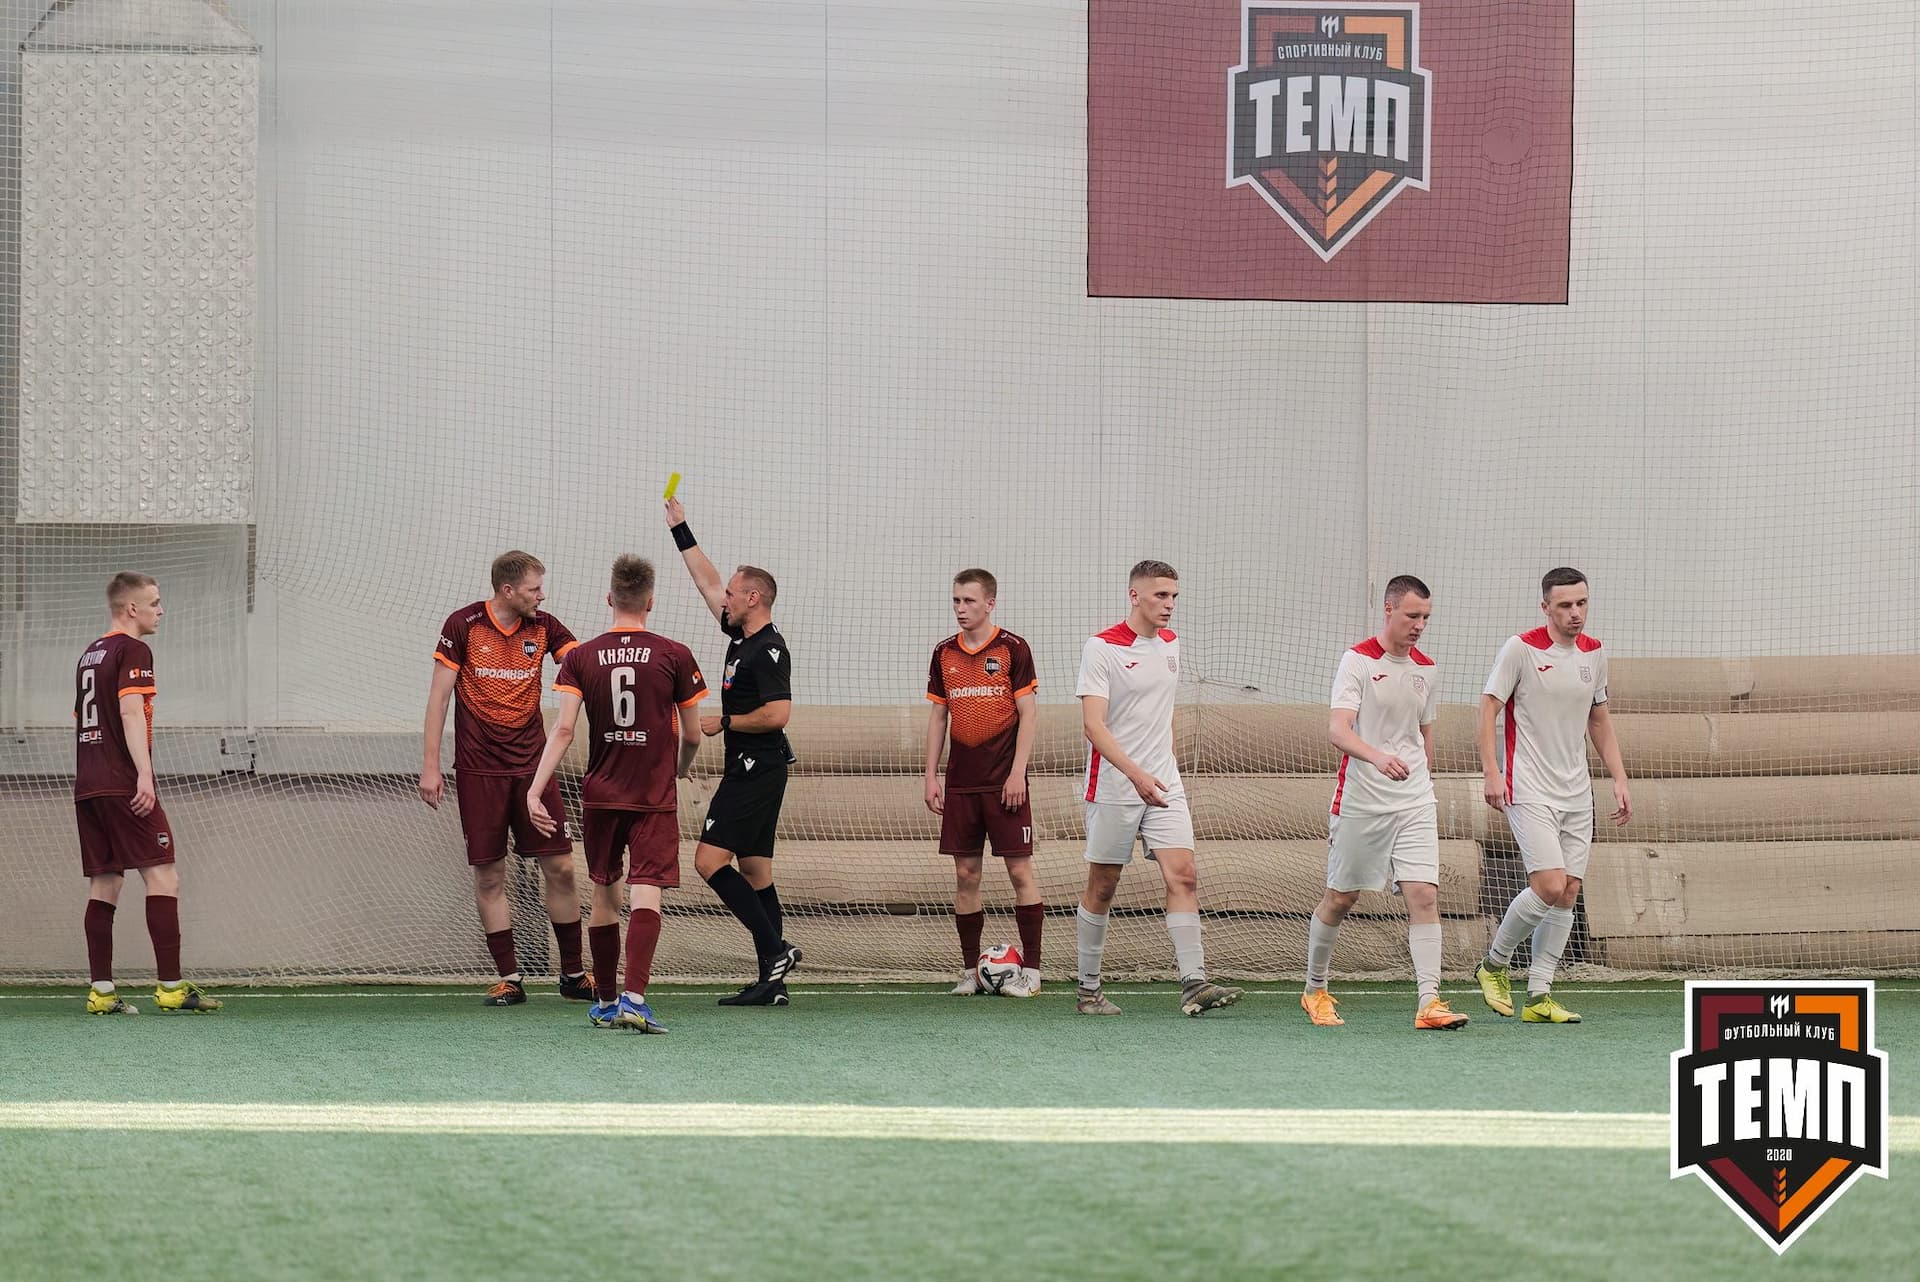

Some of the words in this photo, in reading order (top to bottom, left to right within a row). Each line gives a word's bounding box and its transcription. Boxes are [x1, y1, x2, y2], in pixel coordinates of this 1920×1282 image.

[1277, 40, 1351, 60] СПОРТИВНЫЙ
[1354, 45, 1383, 61] КЛУБ
[1249, 75, 1410, 162] ТЕМП
[598, 647, 651, 666] КНЯЗЕВ
[81, 668, 99, 729] 2
[610, 666, 636, 727] 6
[604, 730, 648, 743] SEUS
[1022, 826, 1031, 844] 17
